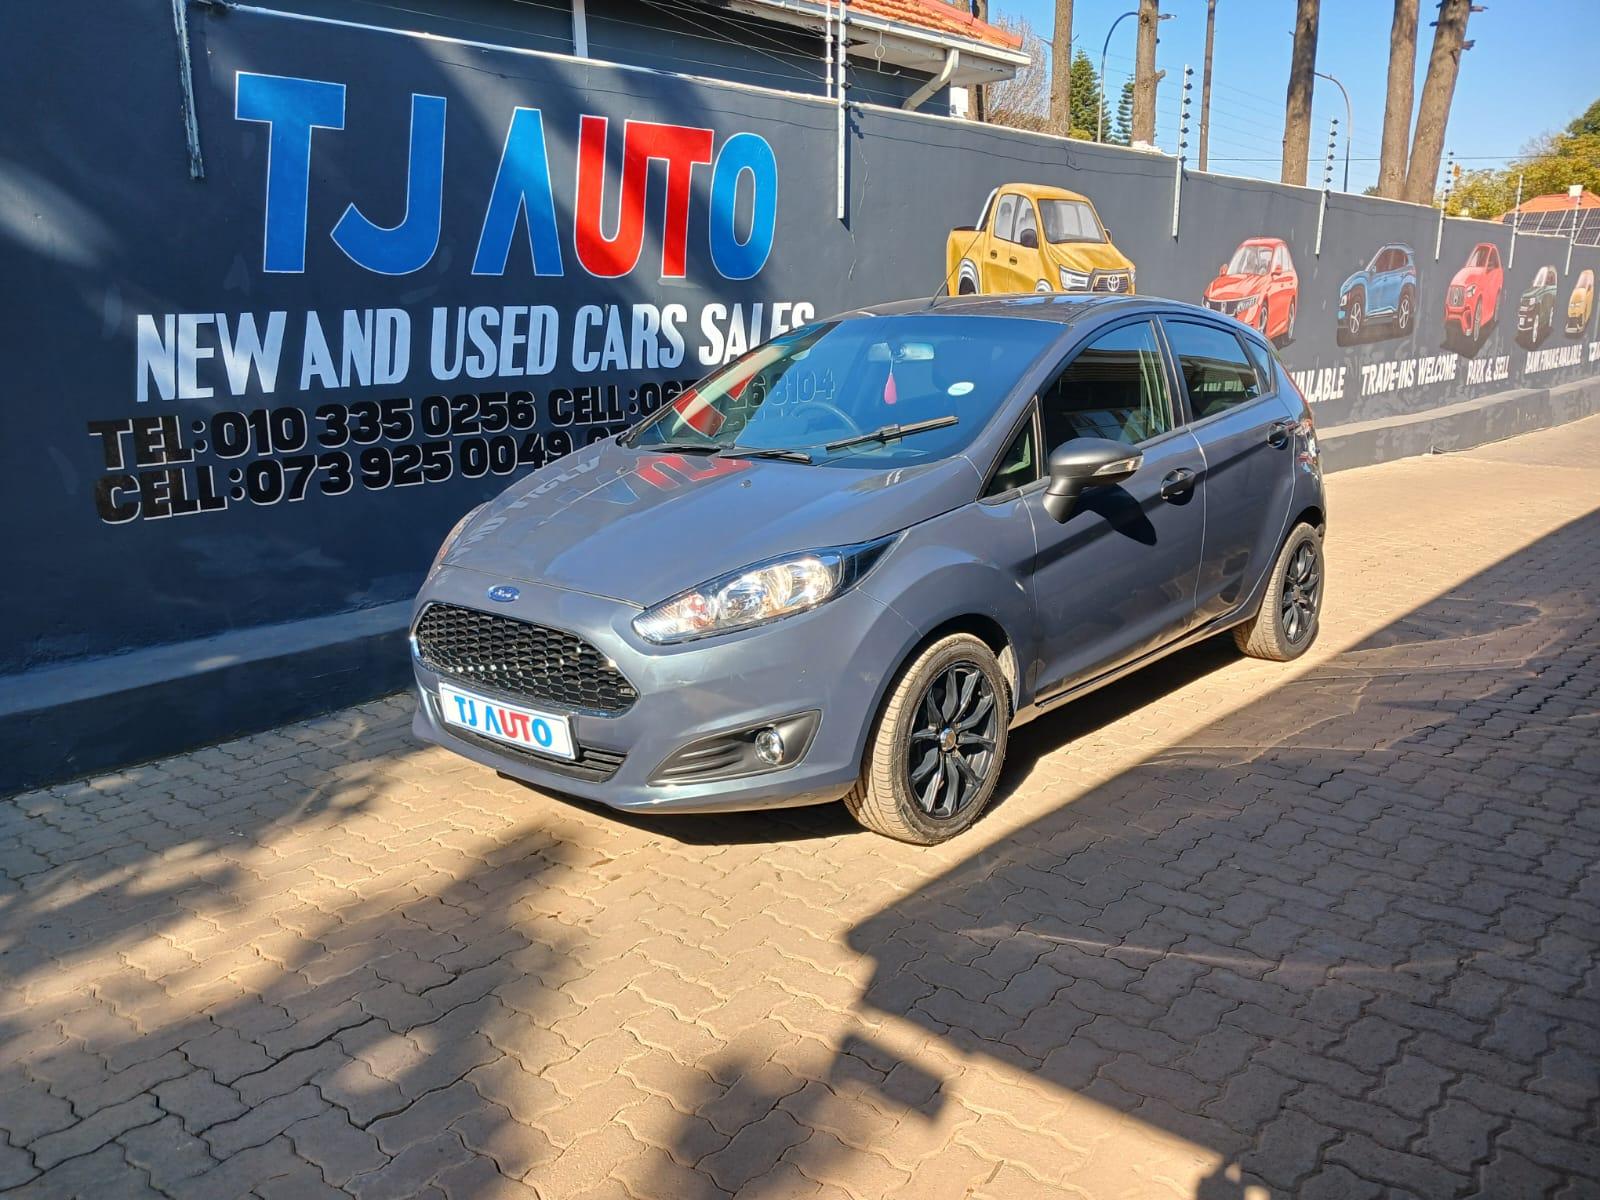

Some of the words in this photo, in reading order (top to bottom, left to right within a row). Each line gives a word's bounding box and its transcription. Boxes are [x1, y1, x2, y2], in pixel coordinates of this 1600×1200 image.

[235, 71, 448, 276] TJ
[471, 106, 779, 281] AUTO
[136, 311, 289, 403] NEW
[300, 307, 412, 393] AND
[430, 304, 558, 382] USED
[572, 302, 688, 371] CARS
[1361, 359, 1417, 396] TRADE-INS
[1417, 353, 1458, 386] WELCOME
[1466, 359, 1487, 386] PARK
[1493, 355, 1510, 380] SELL
[1291, 366, 1347, 403] AILABLE
[315, 397, 415, 448] 335
[421, 391, 537, 438] 0256
[359, 440, 453, 491] 925
[459, 431, 574, 479] 0049
[454, 696, 477, 727] TJ
[485, 706, 553, 748] AUTO
